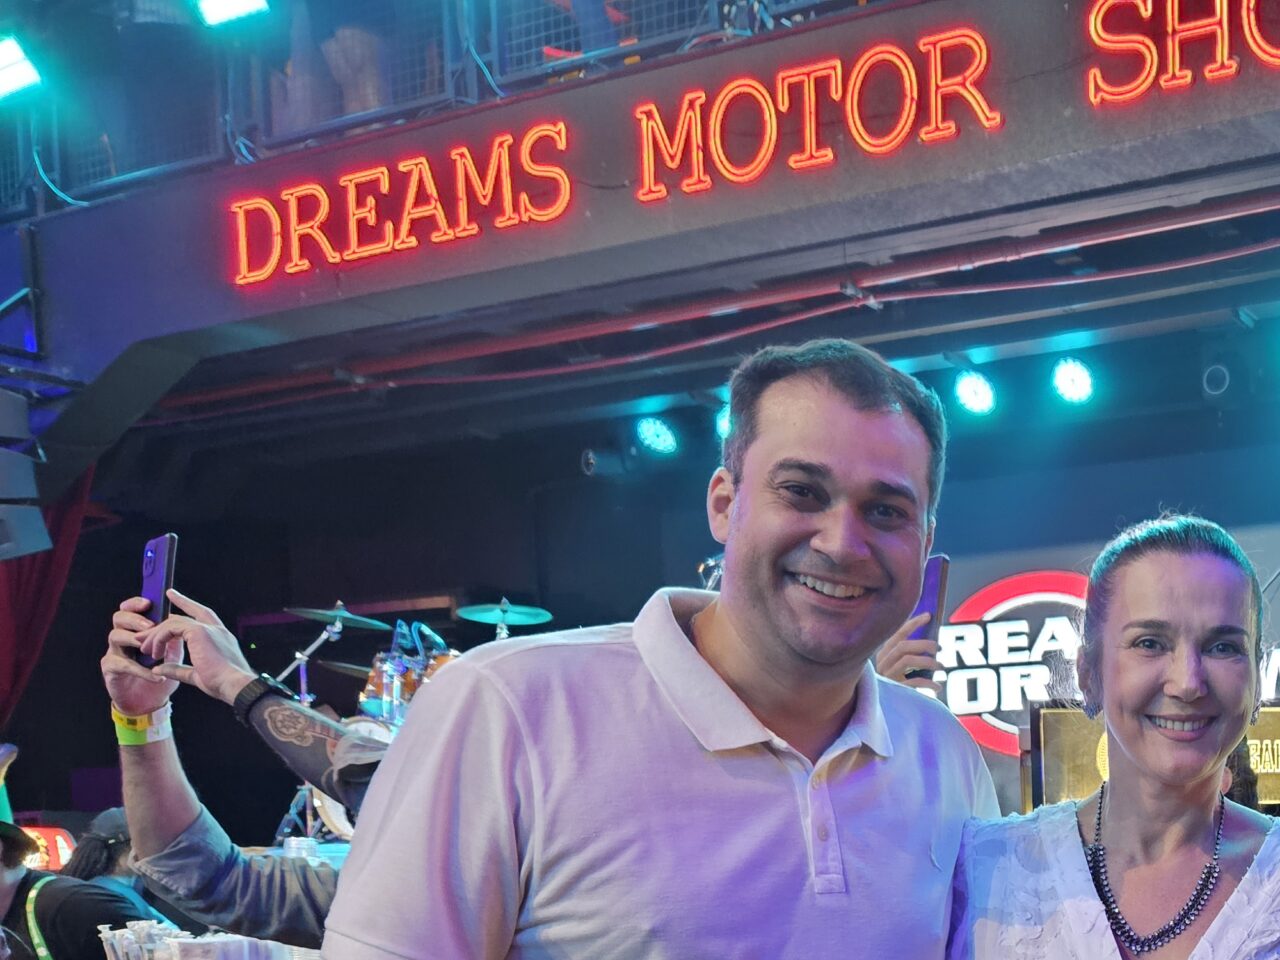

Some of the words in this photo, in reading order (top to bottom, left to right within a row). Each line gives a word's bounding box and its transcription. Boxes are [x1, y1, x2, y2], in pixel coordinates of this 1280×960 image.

[231, 121, 571, 286] DREAMS
[635, 26, 1002, 202] MOTOR
[935, 615, 1084, 668] REA
